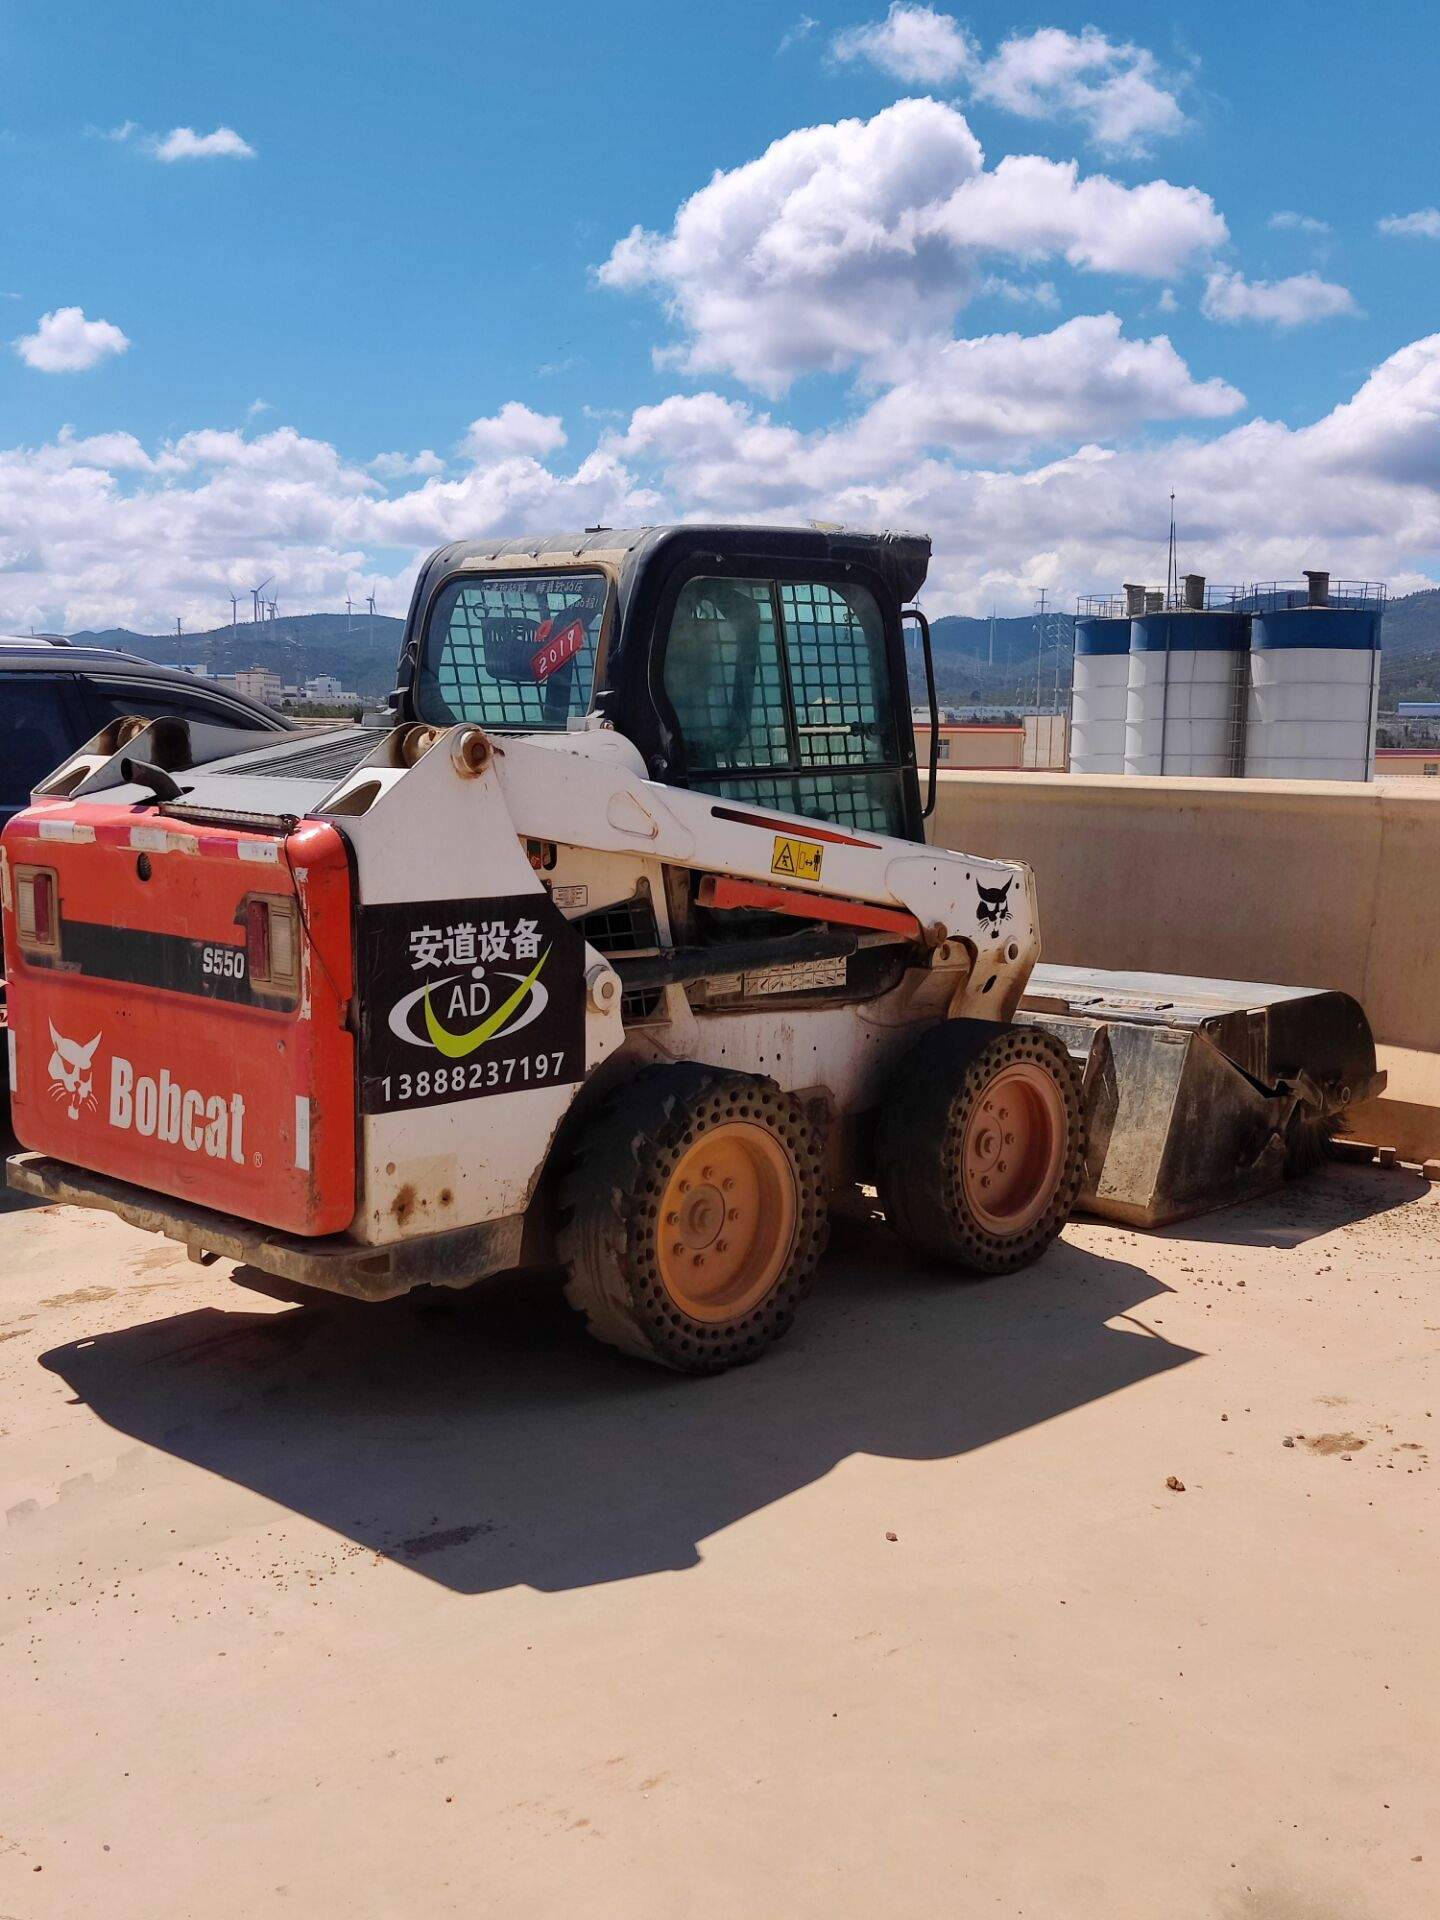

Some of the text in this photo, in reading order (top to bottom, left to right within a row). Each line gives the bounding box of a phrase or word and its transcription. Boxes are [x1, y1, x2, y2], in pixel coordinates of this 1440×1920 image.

[539, 628, 575, 674] 2019
[203, 947, 245, 979] S550
[409, 917, 544, 971] 安道设备
[447, 983, 491, 1019] AD
[381, 1051, 565, 1102] 13888237197
[109, 1055, 246, 1165] Bobcat
